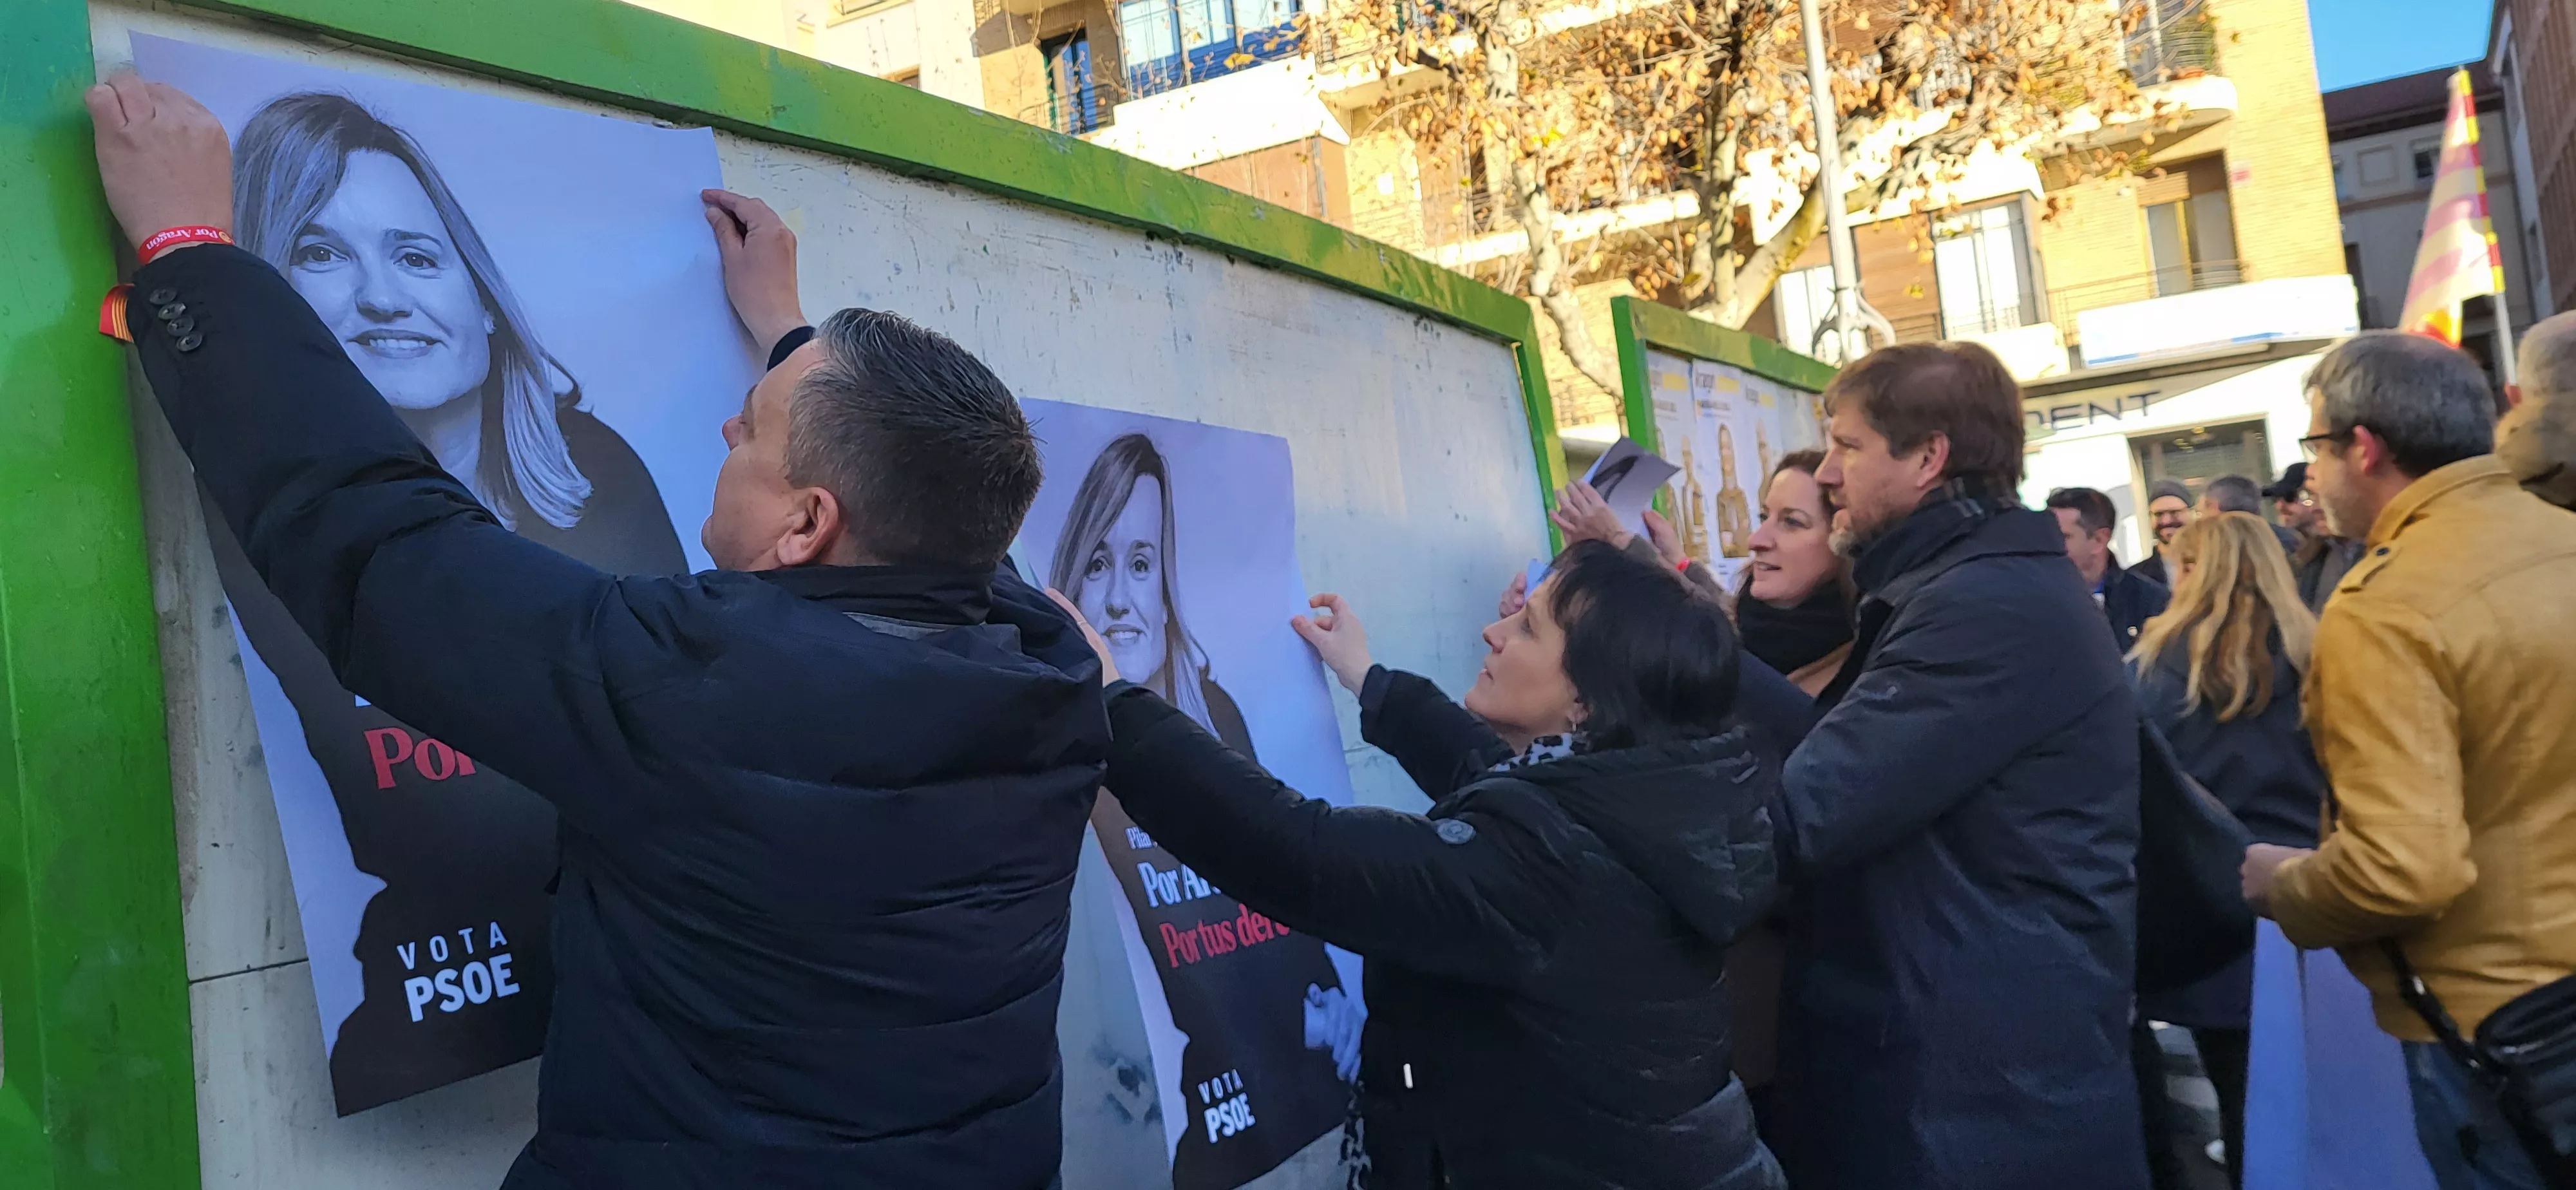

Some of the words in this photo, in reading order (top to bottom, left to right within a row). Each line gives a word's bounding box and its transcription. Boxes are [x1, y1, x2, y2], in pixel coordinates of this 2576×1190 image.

[146, 229, 191, 250] Aragón
[195, 229, 218, 239] Por
[1137, 862, 1182, 908] Por
[397, 921, 507, 970] VOTA
[1159, 922, 1202, 968] Por
[1197, 912, 1237, 958] tus
[404, 953, 520, 1023] PSOE
[1198, 1068, 1244, 1104] VOTA
[1203, 1092, 1256, 1144] PSOE
